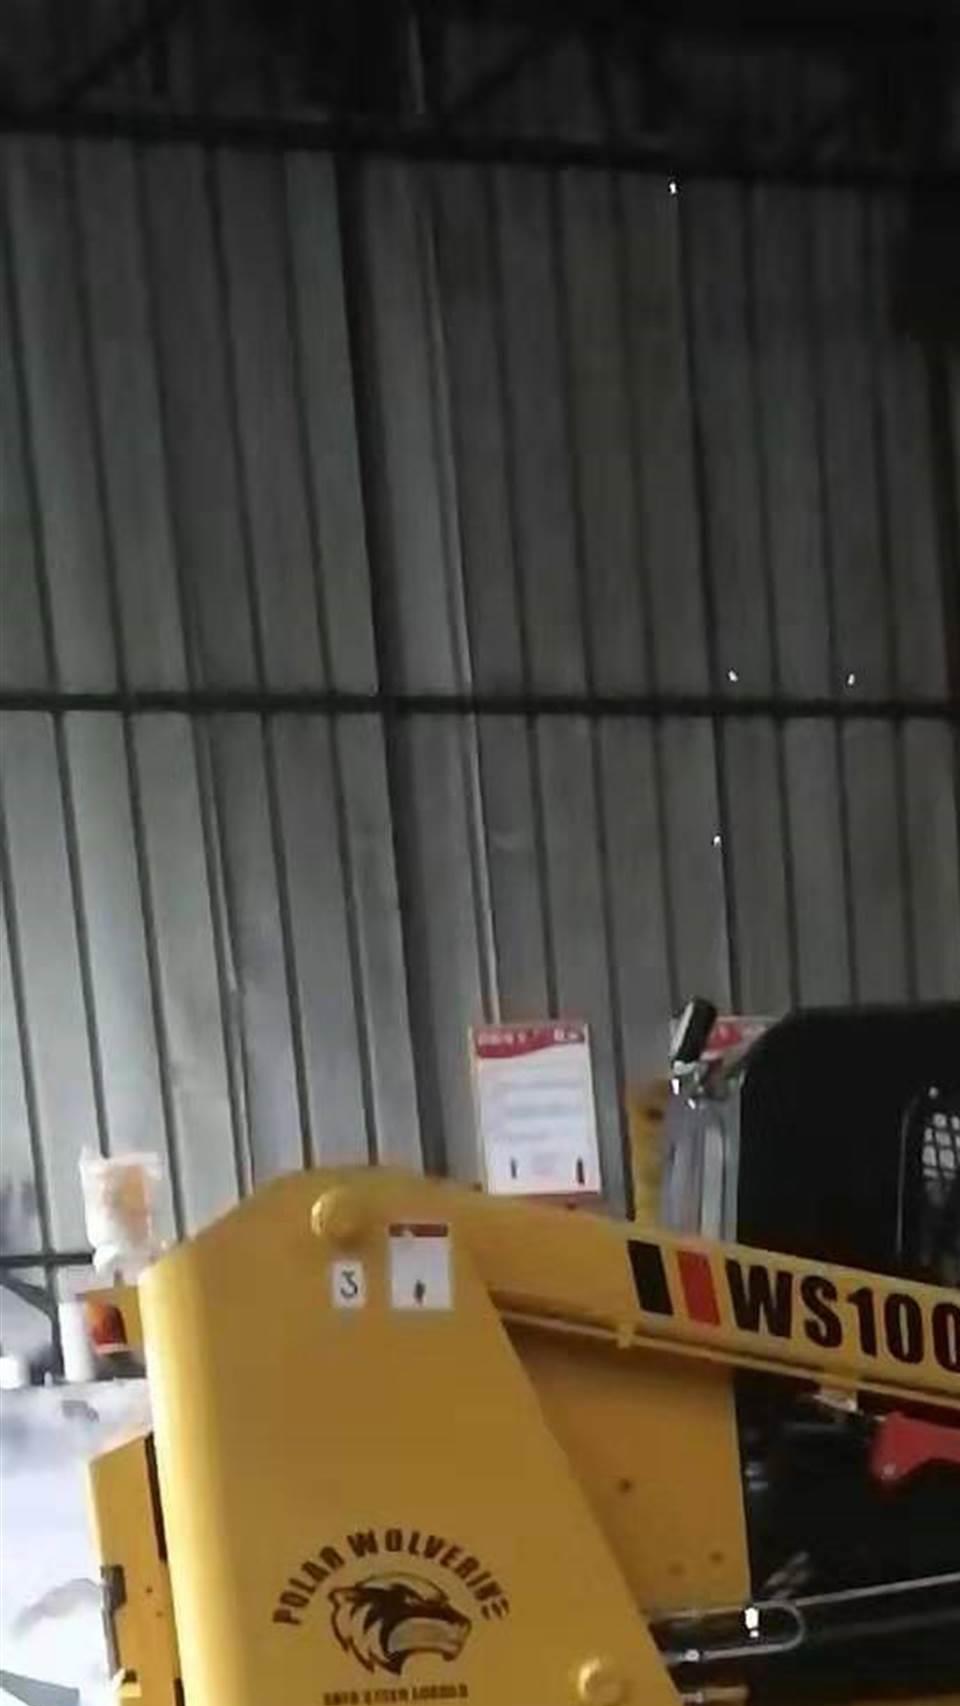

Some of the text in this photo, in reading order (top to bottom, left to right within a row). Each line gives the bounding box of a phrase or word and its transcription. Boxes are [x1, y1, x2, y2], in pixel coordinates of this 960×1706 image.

[340, 1268, 358, 1299] 3
[272, 1527, 510, 1625] POLAR WOLVERINE
